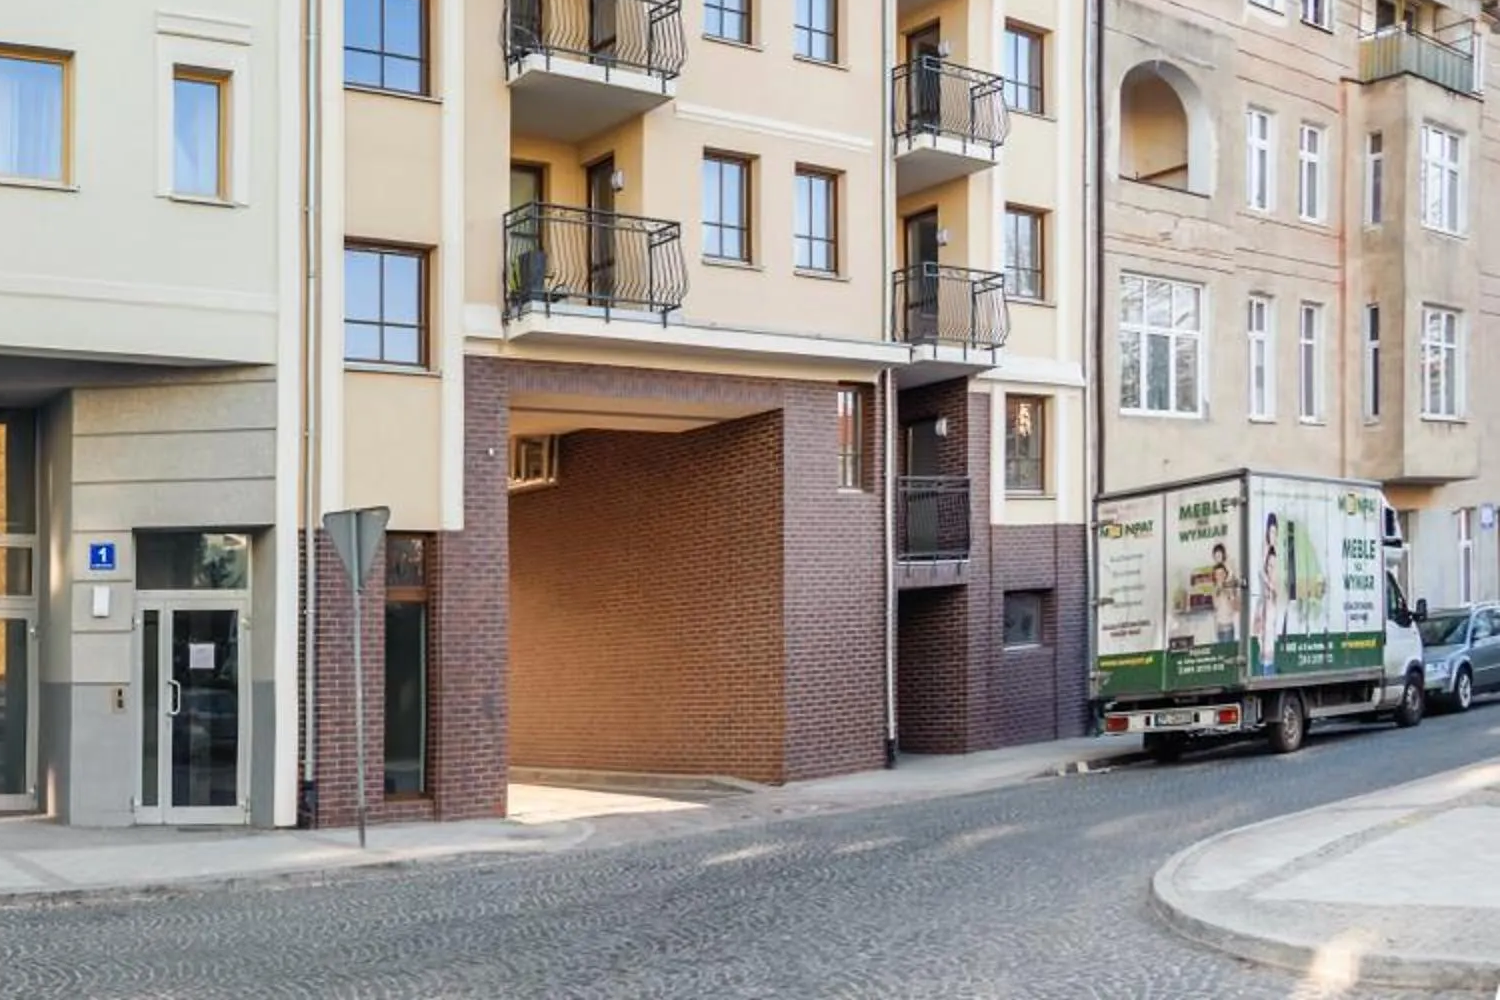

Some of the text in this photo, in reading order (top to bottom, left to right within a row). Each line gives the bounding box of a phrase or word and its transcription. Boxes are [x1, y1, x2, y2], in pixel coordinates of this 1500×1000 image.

[1178, 498, 1229, 520] MEBLE
[98, 547, 106, 562] 1
[1342, 537, 1375, 559] MEBLE
